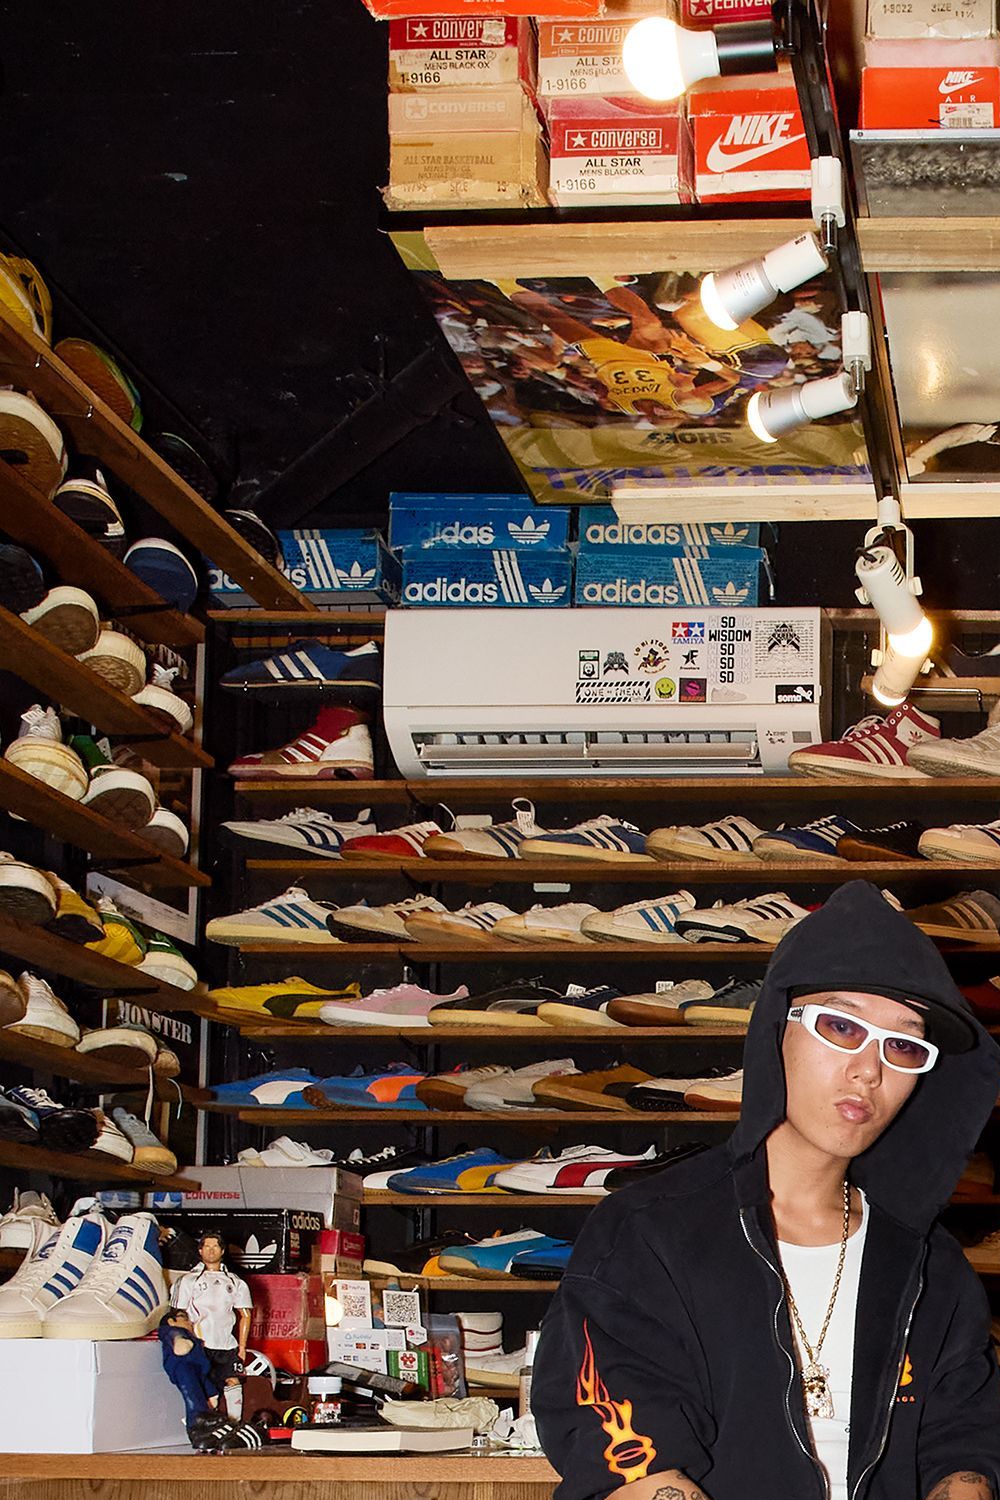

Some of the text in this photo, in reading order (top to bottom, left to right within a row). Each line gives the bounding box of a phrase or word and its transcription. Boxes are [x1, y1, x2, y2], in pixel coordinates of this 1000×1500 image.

[433, 20, 484, 39] conver
[430, 50, 487, 60] ALL STAR
[424, 62, 448, 71] MENS
[576, 57, 598, 67] ALL
[400, 71, 441, 84] 1-9166
[945, 70, 976, 84] NIKE
[546, 78, 587, 91] 1-9166
[722, 113, 795, 146] NIKE
[403, 155, 496, 165] ALL STAR BASKETBALL
[585, 157, 642, 168] ALL STAR
[604, 168, 630, 176] BLACK
[556, 178, 597, 191] 1-9166
[613, 369, 656, 385] 33
[585, 523, 681, 545] adidas
[404, 577, 498, 602] adidas
[583, 578, 679, 604] adidas
[708, 629, 751, 642] WISDOM
[777, 694, 802, 703] soma
[116, 999, 192, 1045] MONSTER
[291, 1211, 321, 1231] adidas
[233, 1362, 244, 1373] 13
